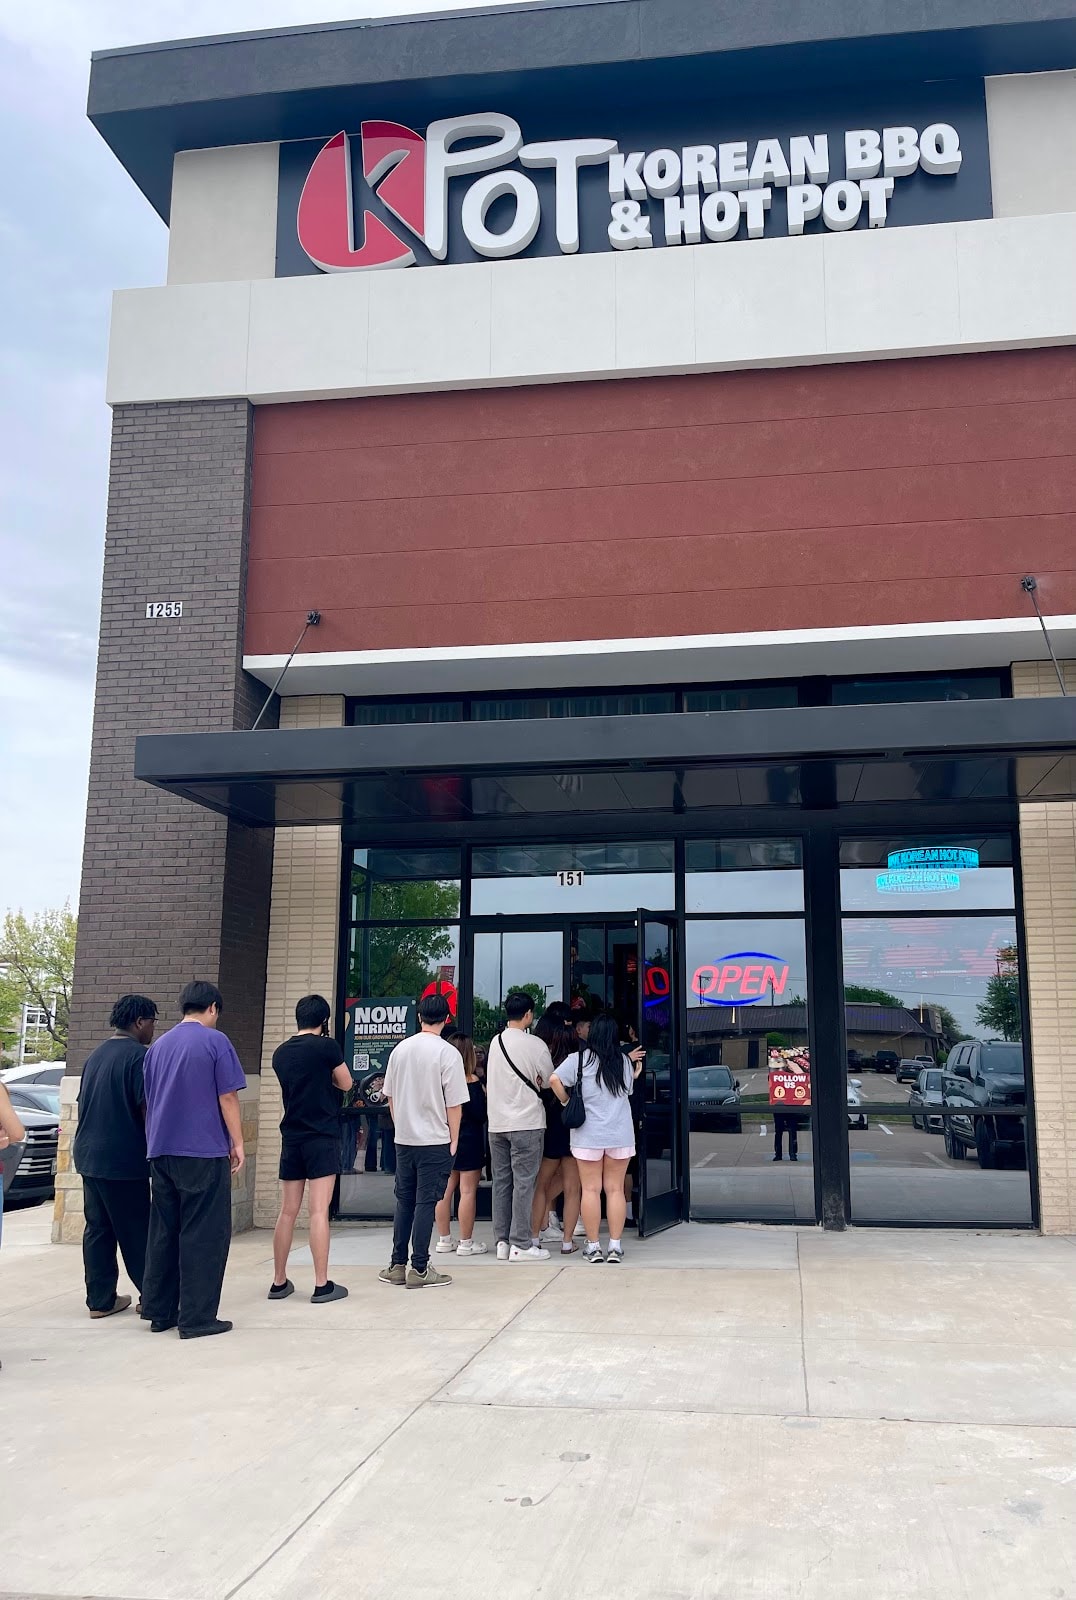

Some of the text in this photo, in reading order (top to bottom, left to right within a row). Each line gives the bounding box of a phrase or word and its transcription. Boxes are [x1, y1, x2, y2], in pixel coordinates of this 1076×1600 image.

[608, 123, 962, 201] KOREAN BBQ
[607, 177, 894, 250] & HOT POT
[148, 602, 181, 617] 1255
[901, 849, 938, 863] KOREAN
[939, 849, 958, 861] HOT
[558, 871, 582, 886] 151
[691, 965, 789, 995] OPEN
[355, 1006, 408, 1023] NOW
[354, 1022, 407, 1034] HIRING!
